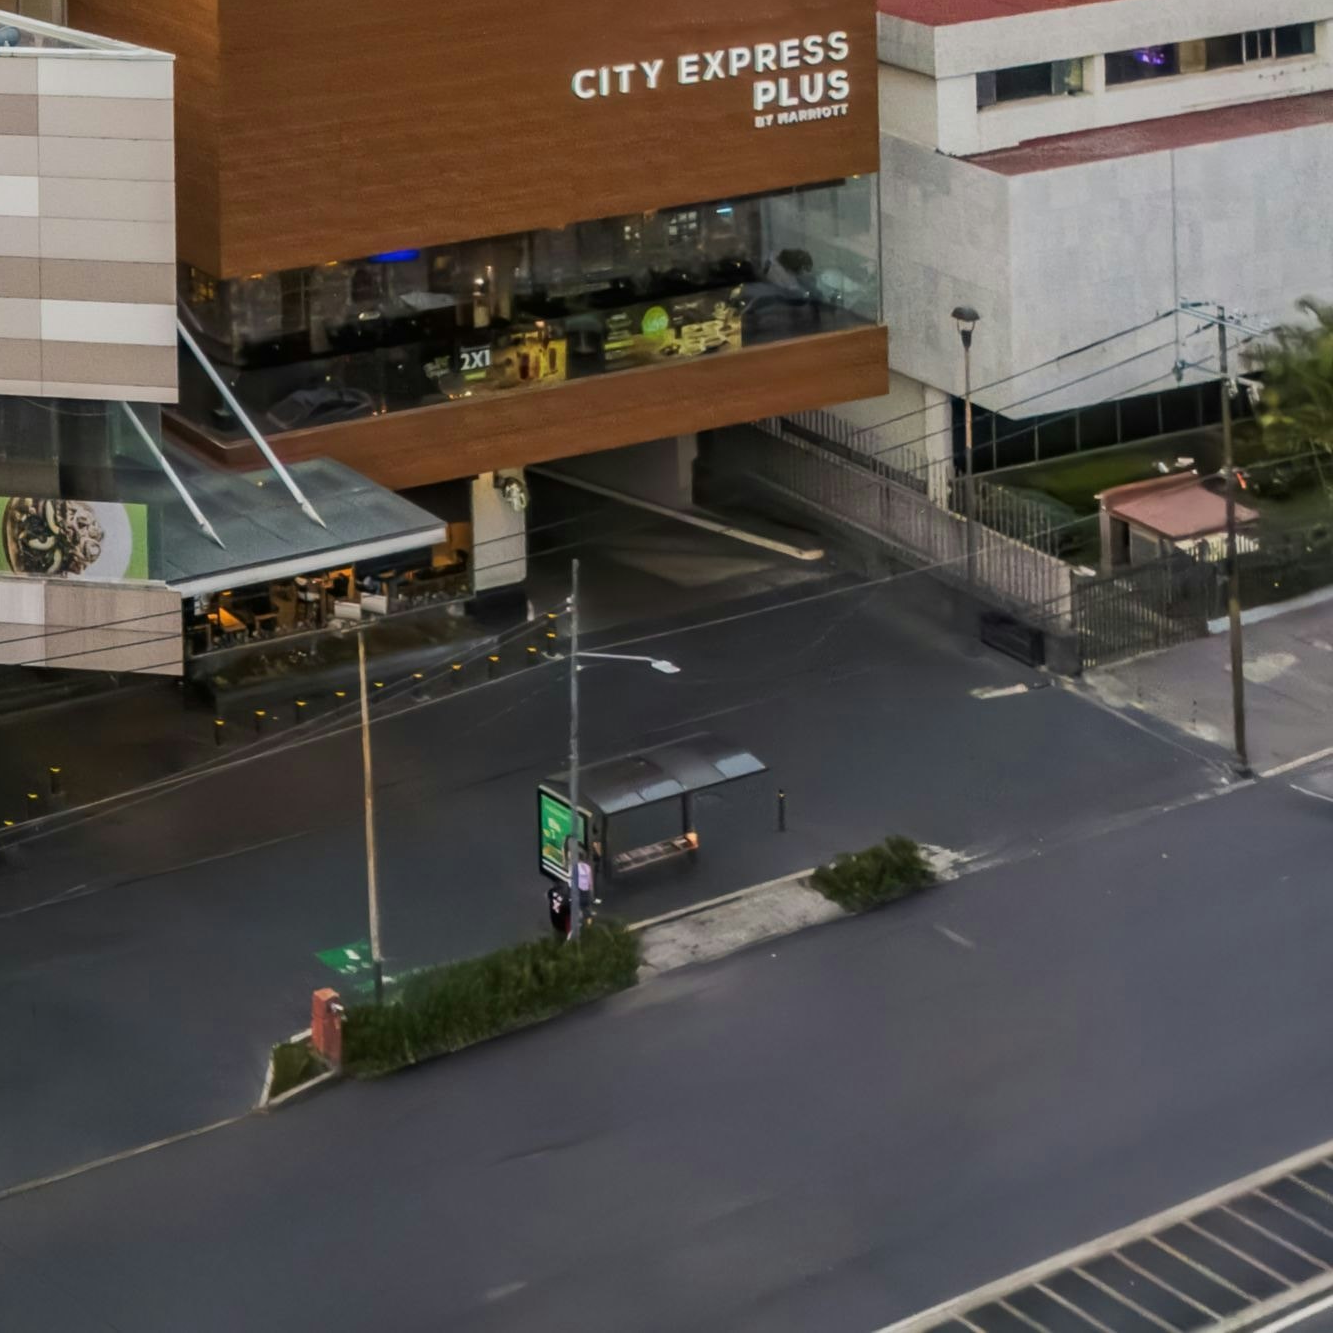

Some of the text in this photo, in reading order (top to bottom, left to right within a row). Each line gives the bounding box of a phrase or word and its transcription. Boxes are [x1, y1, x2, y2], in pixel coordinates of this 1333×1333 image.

[572, 31, 849, 99] CITY EXPRESS
[753, 70, 850, 111] PLUS
[754, 103, 849, 128] BY MARRIOTT
